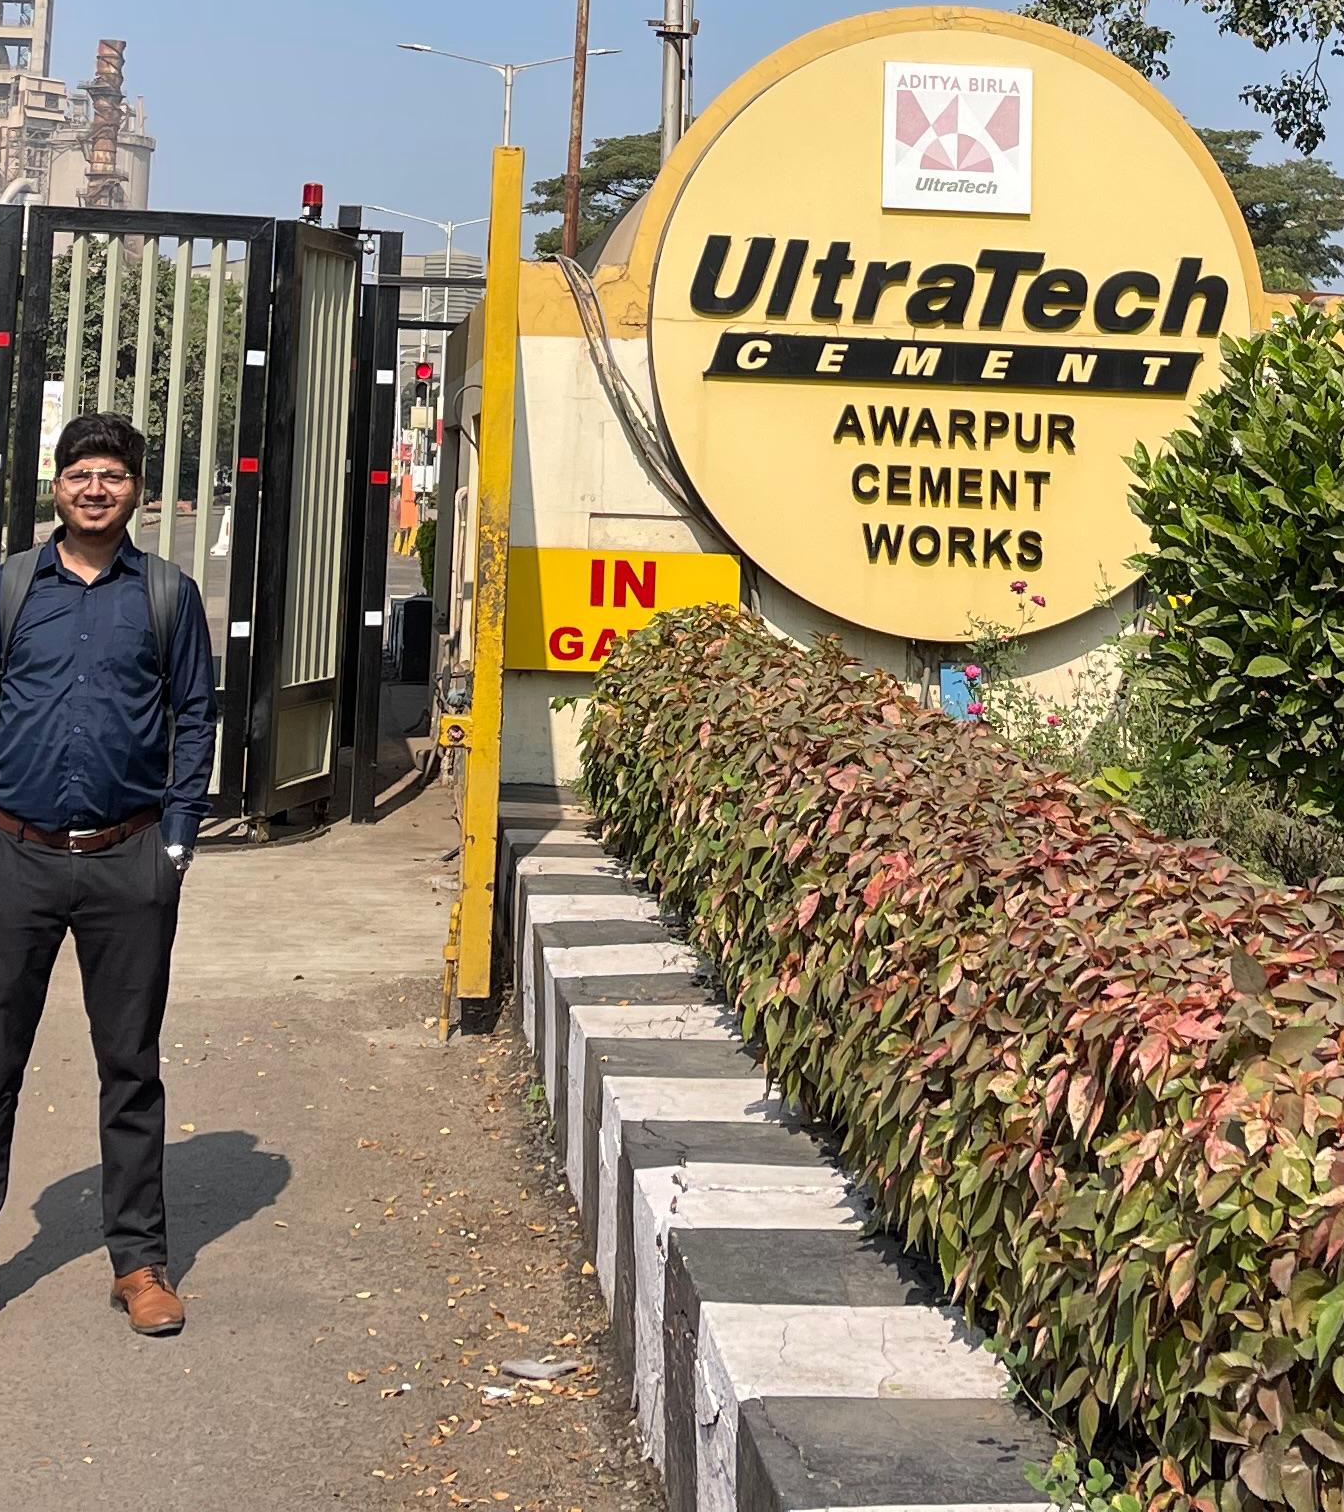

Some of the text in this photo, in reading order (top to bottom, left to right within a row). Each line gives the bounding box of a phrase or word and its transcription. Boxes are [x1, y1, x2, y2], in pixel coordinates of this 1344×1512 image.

[897, 74, 1020, 94] ADITYA BIRLA
[915, 176, 998, 195] UltraTech
[690, 234, 1229, 338] UltraTech
[735, 339, 1170, 386] CEMENT
[833, 403, 1076, 455] AWARPUR
[851, 462, 1051, 511] CEMENT
[862, 522, 1043, 572] WORKS
[589, 559, 657, 609] IN
[548, 626, 641, 662] GA
